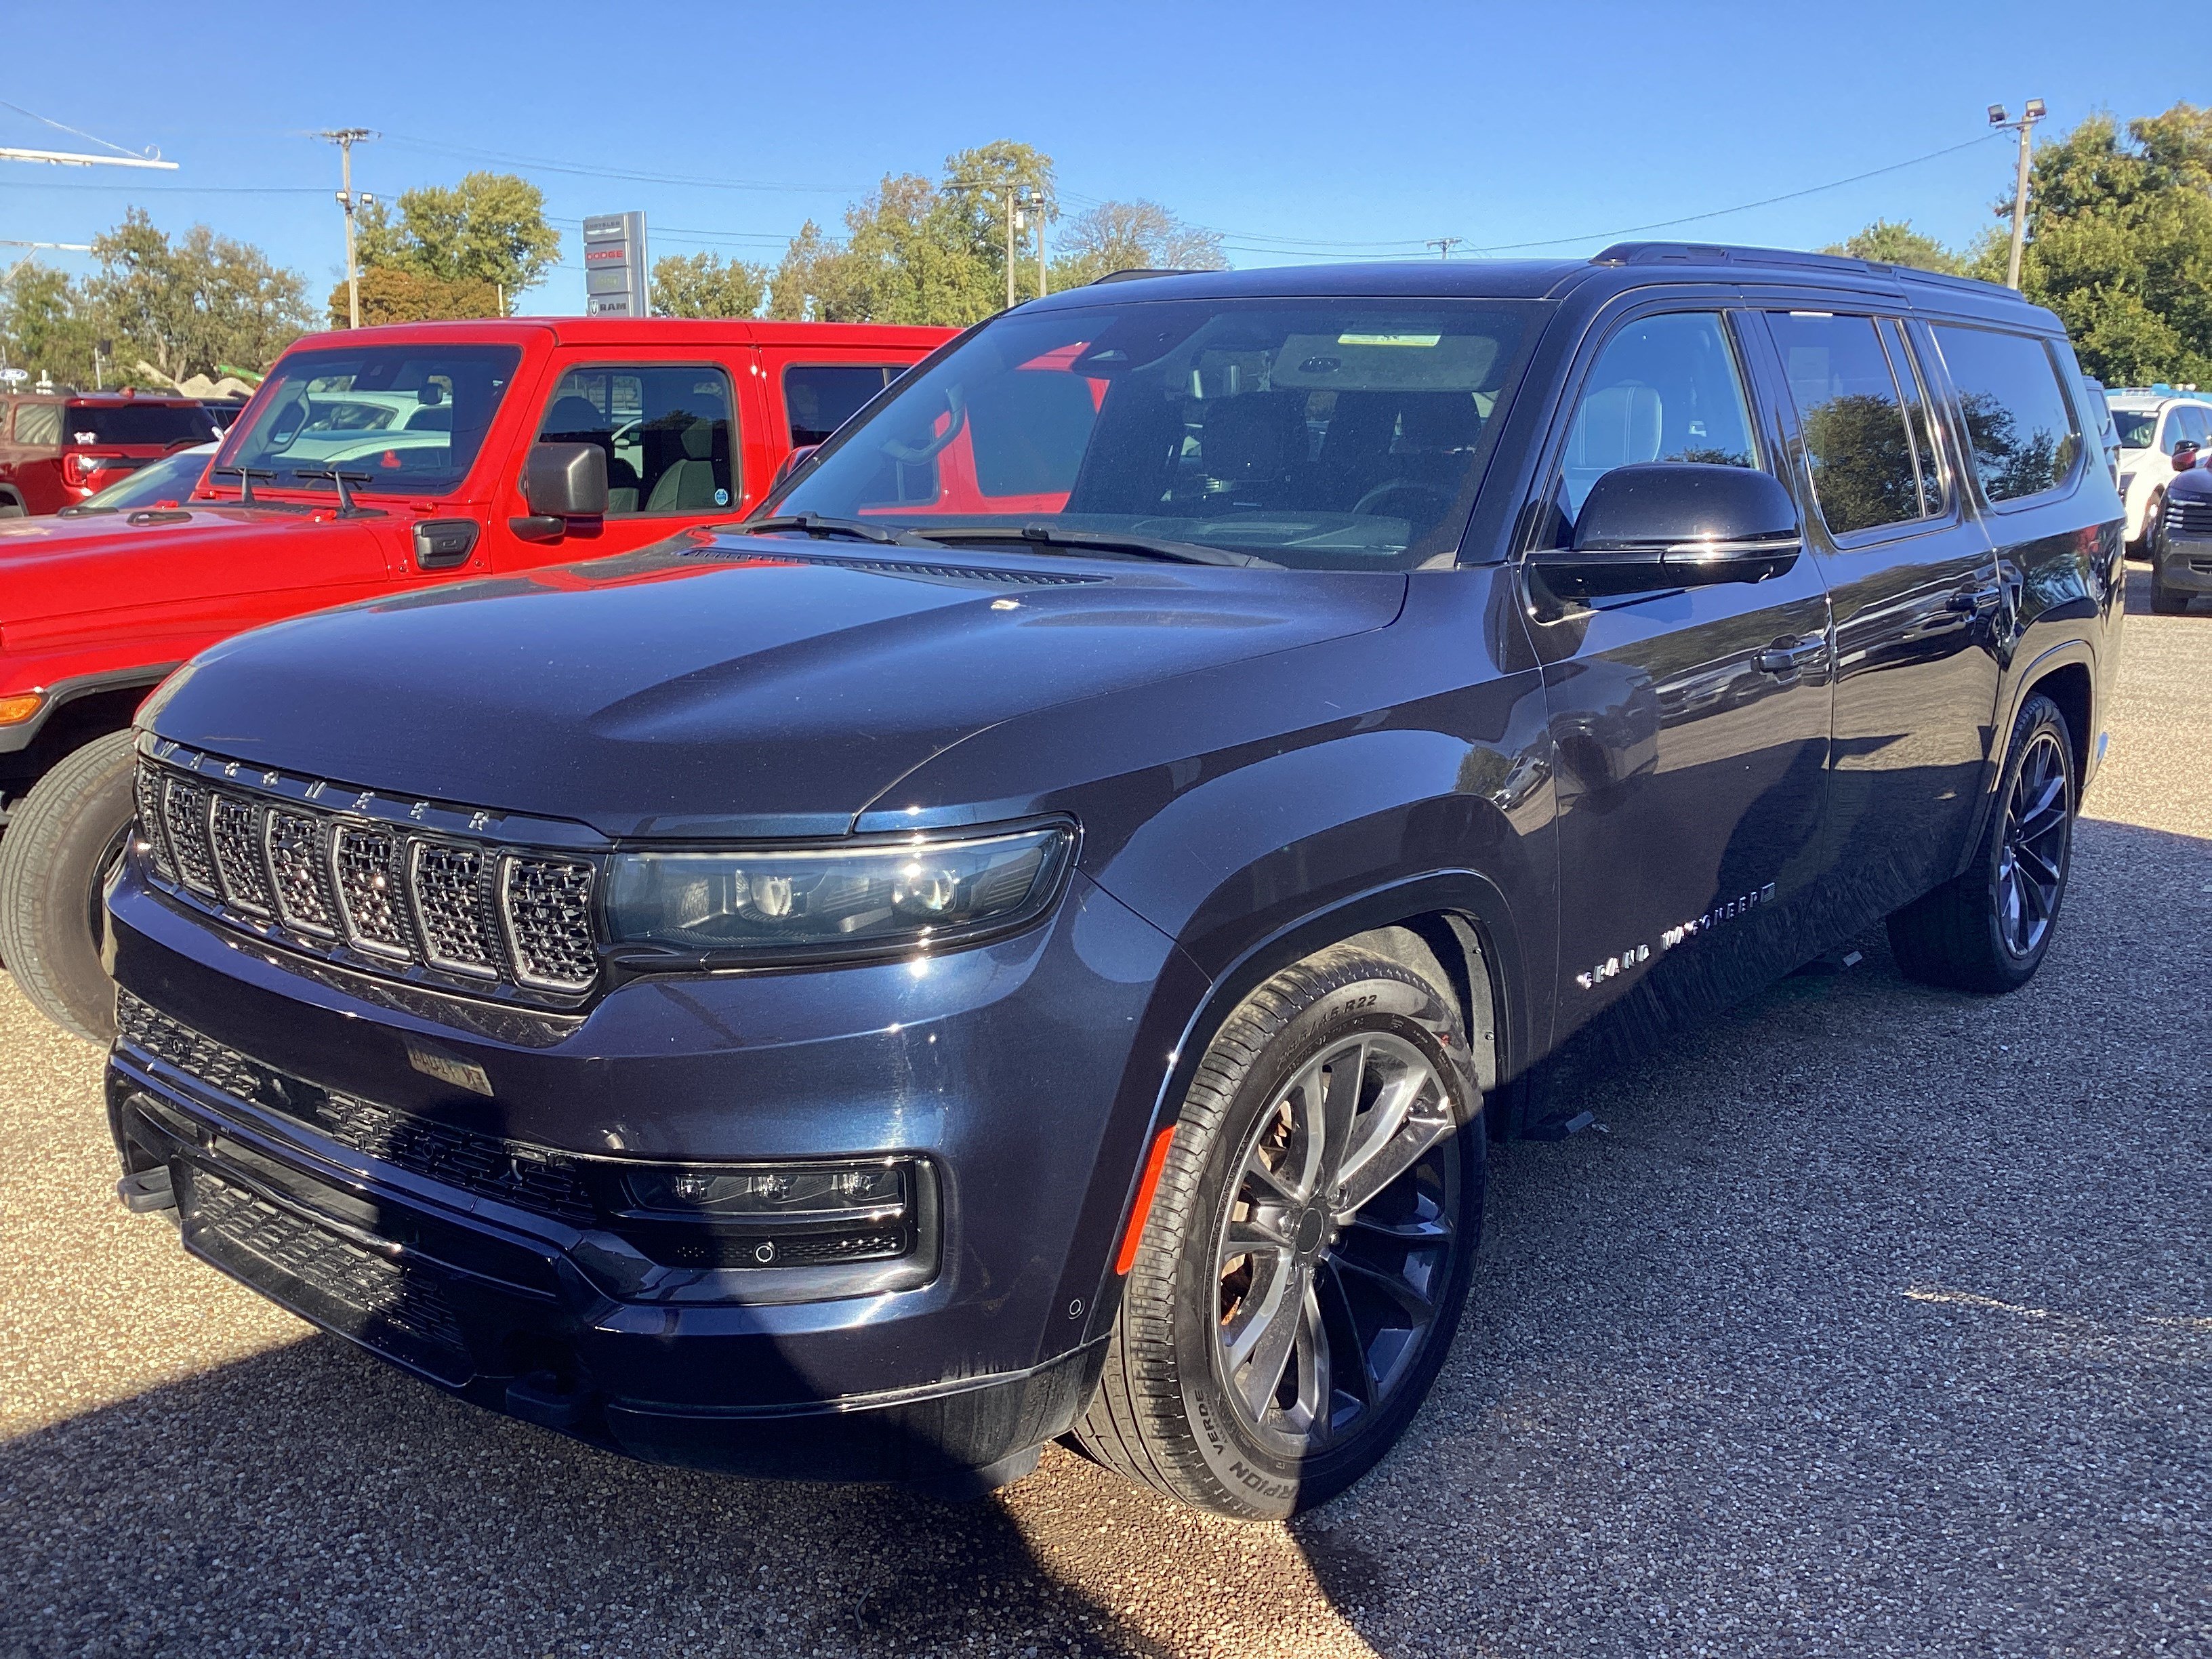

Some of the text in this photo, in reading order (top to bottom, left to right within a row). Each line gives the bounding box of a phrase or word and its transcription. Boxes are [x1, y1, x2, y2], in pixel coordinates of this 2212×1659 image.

[586, 221, 621, 229] CHRYSLER
[587, 251, 623, 260] DODGE
[600, 303, 626, 311] RAM
[159, 741, 491, 832] WAGONEER
[1343, 994, 1378, 1014] R22
[1194, 1389, 1224, 1456] VERDE
